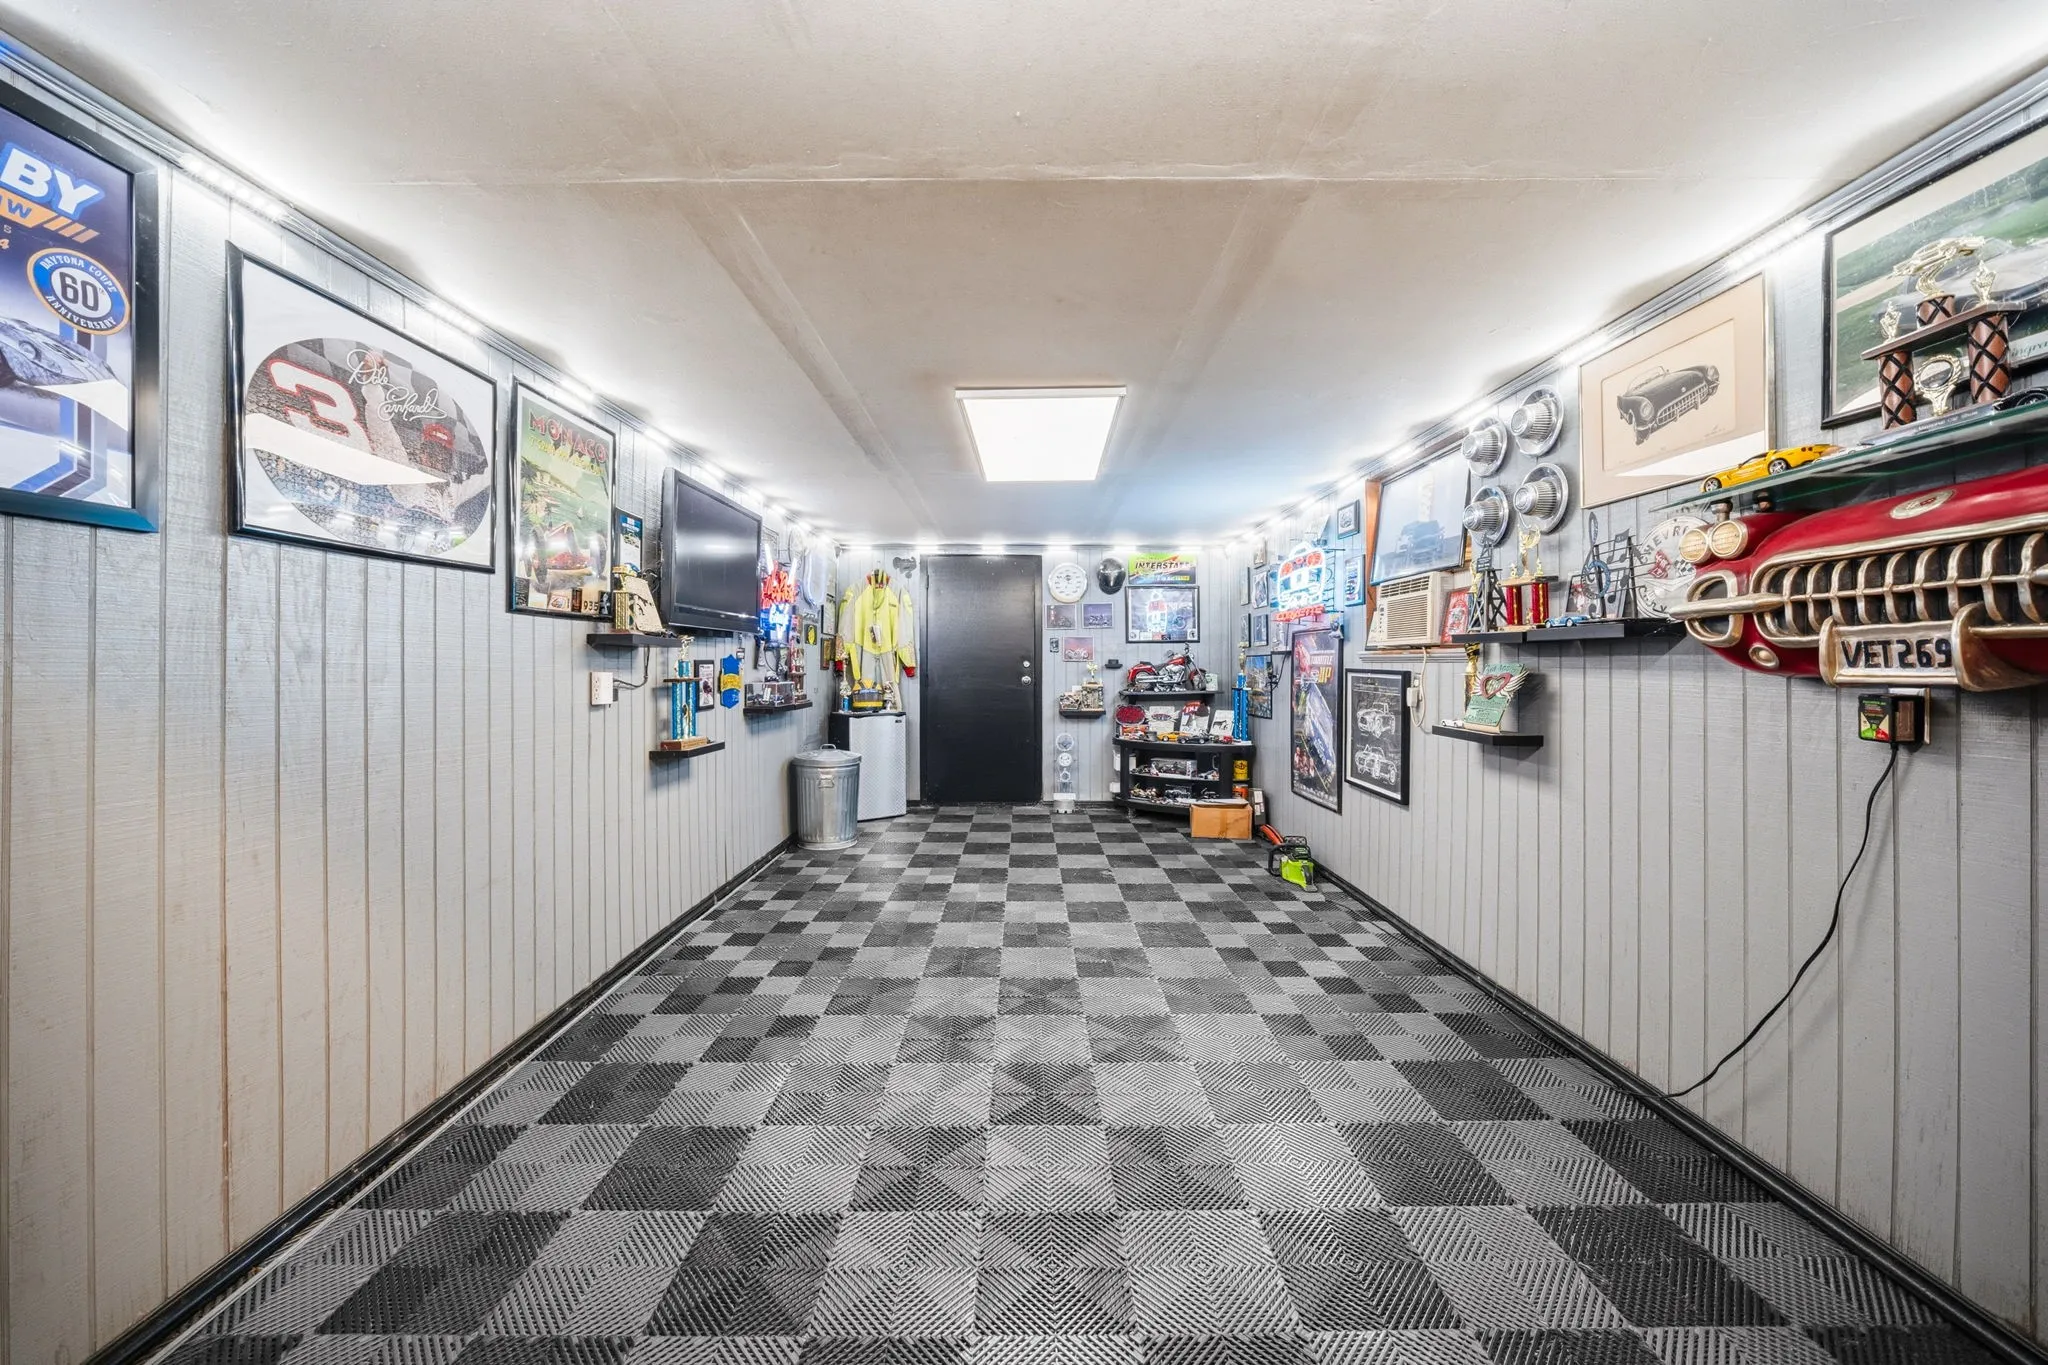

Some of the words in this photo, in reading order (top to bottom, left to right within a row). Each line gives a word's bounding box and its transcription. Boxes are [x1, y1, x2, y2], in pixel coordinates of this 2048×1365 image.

[1, 147, 100, 214] BY
[0, 195, 32, 219] W
[39, 254, 85, 271] DAYTONA
[88, 266, 118, 294] COUPE
[46, 294, 117, 330] ANNIVERSARY
[346, 348, 390, 386] Dale
[266, 358, 375, 452] 3
[529, 410, 607, 463] MONACO
[1318, 666, 1333, 684] UP
